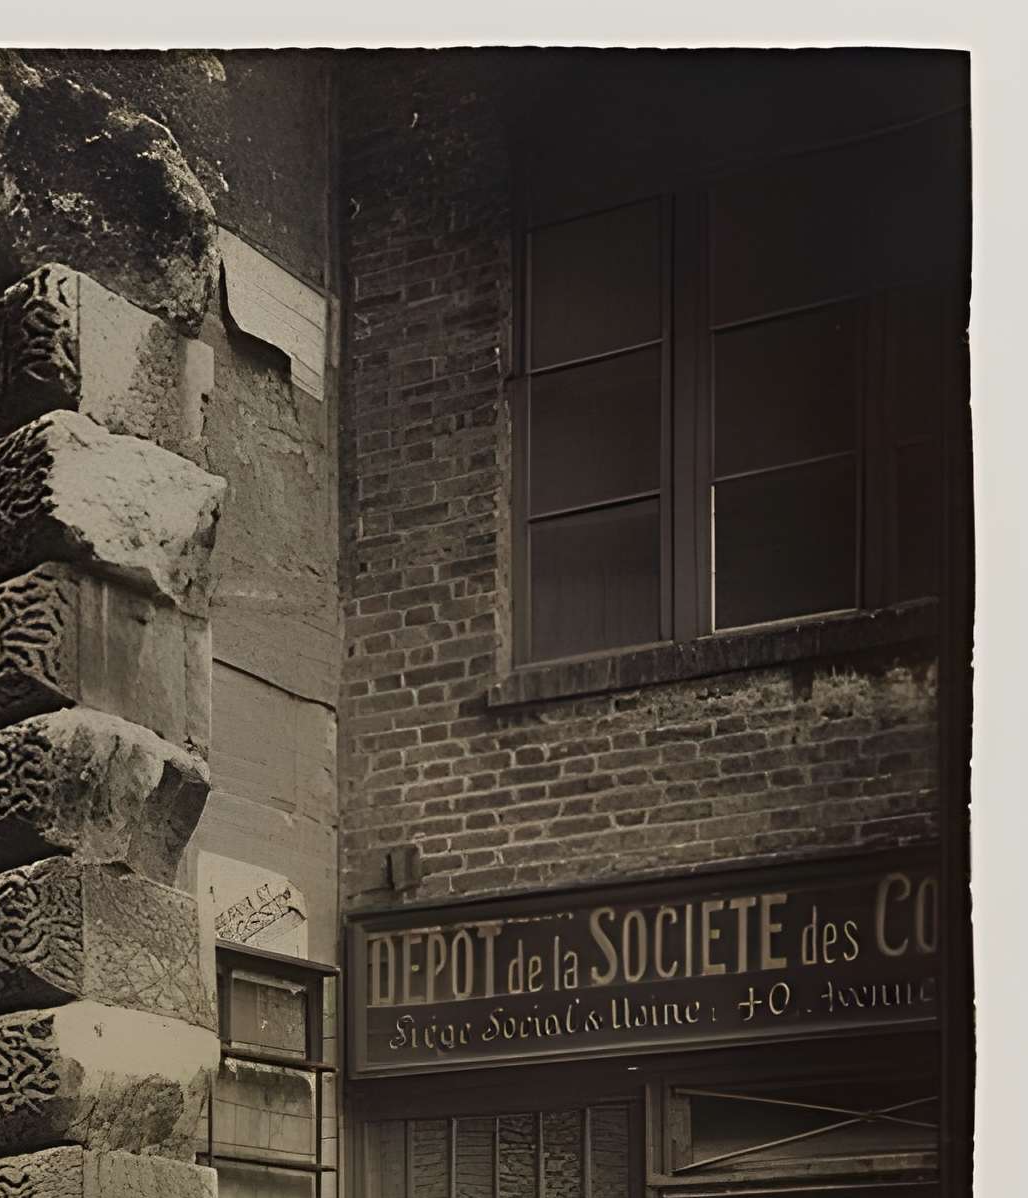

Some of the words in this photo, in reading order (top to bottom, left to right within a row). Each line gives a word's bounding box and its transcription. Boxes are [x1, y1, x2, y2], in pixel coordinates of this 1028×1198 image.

[371, 926, 504, 1005] DEPOT
[509, 938, 544, 995] de
[553, 935, 579, 992] la
[801, 904, 861, 967] des
